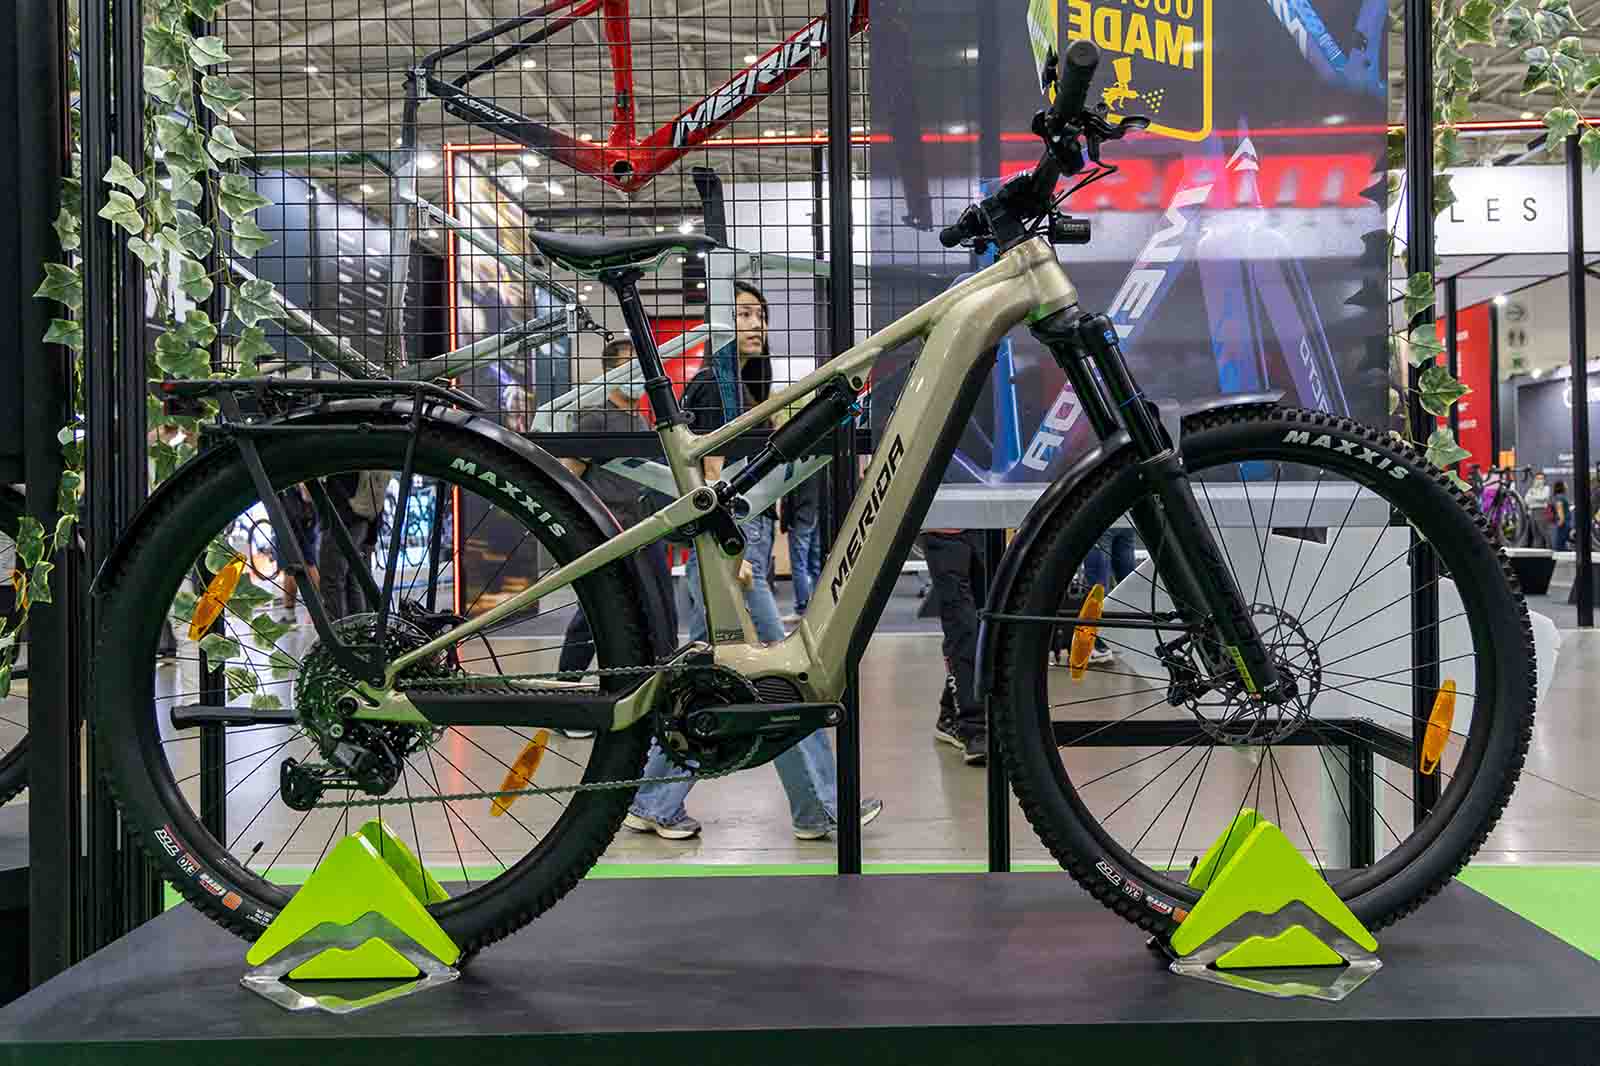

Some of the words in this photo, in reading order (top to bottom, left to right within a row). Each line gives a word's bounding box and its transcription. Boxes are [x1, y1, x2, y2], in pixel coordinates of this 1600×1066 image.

[672, 20, 829, 148] MERID
[1449, 197, 1538, 223] LES
[1282, 430, 1409, 480] MAXXIS
[449, 457, 567, 537] MAXXIS
[830, 433, 905, 606] MERIDA
